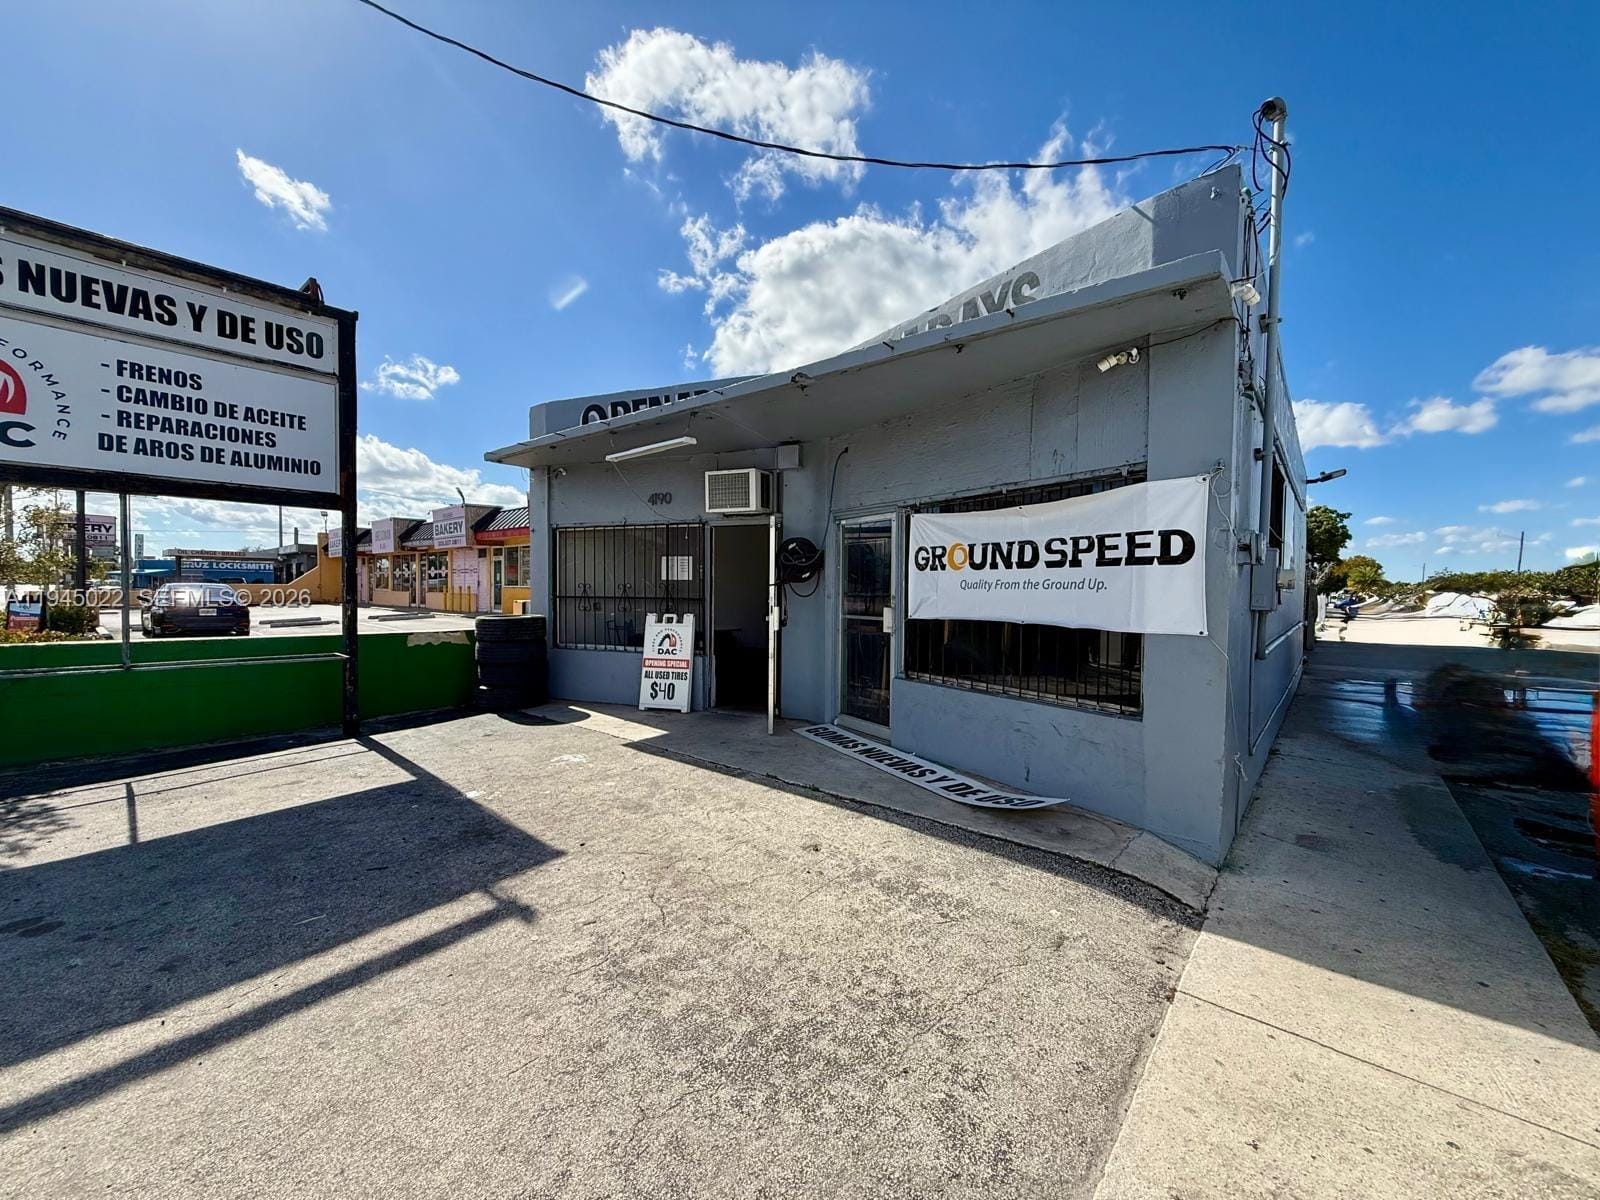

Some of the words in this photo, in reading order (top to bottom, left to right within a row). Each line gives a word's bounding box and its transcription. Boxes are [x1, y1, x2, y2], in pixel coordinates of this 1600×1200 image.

[18, 259, 177, 327] NUEVAS
[187, 302, 208, 333] Y
[217, 309, 257, 345] DE
[265, 320, 324, 359] USO
[116, 359, 203, 391] FRENOS
[116, 385, 208, 415] CAMBIO
[214, 401, 239, 421] DE
[243, 406, 306, 431] ACEITE
[116, 410, 277, 448] REPARACIONES
[98, 432, 128, 453] DE
[133, 438, 194, 461] AROS
[200, 445, 226, 465] DE
[230, 450, 321, 476] ALUMINIO
[648, 492, 672, 506] 4190
[434, 520, 463, 536] BAKERY
[213, 562, 273, 570] LOCKSMITH
[960, 579, 993, 593] Quality
[994, 579, 1020, 590] From
[1022, 579, 1040, 590] the
[1041, 578, 1085, 590] Ground
[1087, 578, 1108, 593] Up.
[645, 659, 666, 667] OPENING
[667, 660, 688, 668] SPECIAL
[644, 670, 654, 679] ALL
[655, 671, 670, 680] USED
[671, 672, 688, 681] TIRES
[650, 681, 675, 700] $40
[805, 726, 862, 750] GOMAS
[857, 746, 936, 778] NUEVAS
[926, 772, 956, 784] Y
[941, 781, 988, 798] DE
[978, 793, 1045, 807] USO
